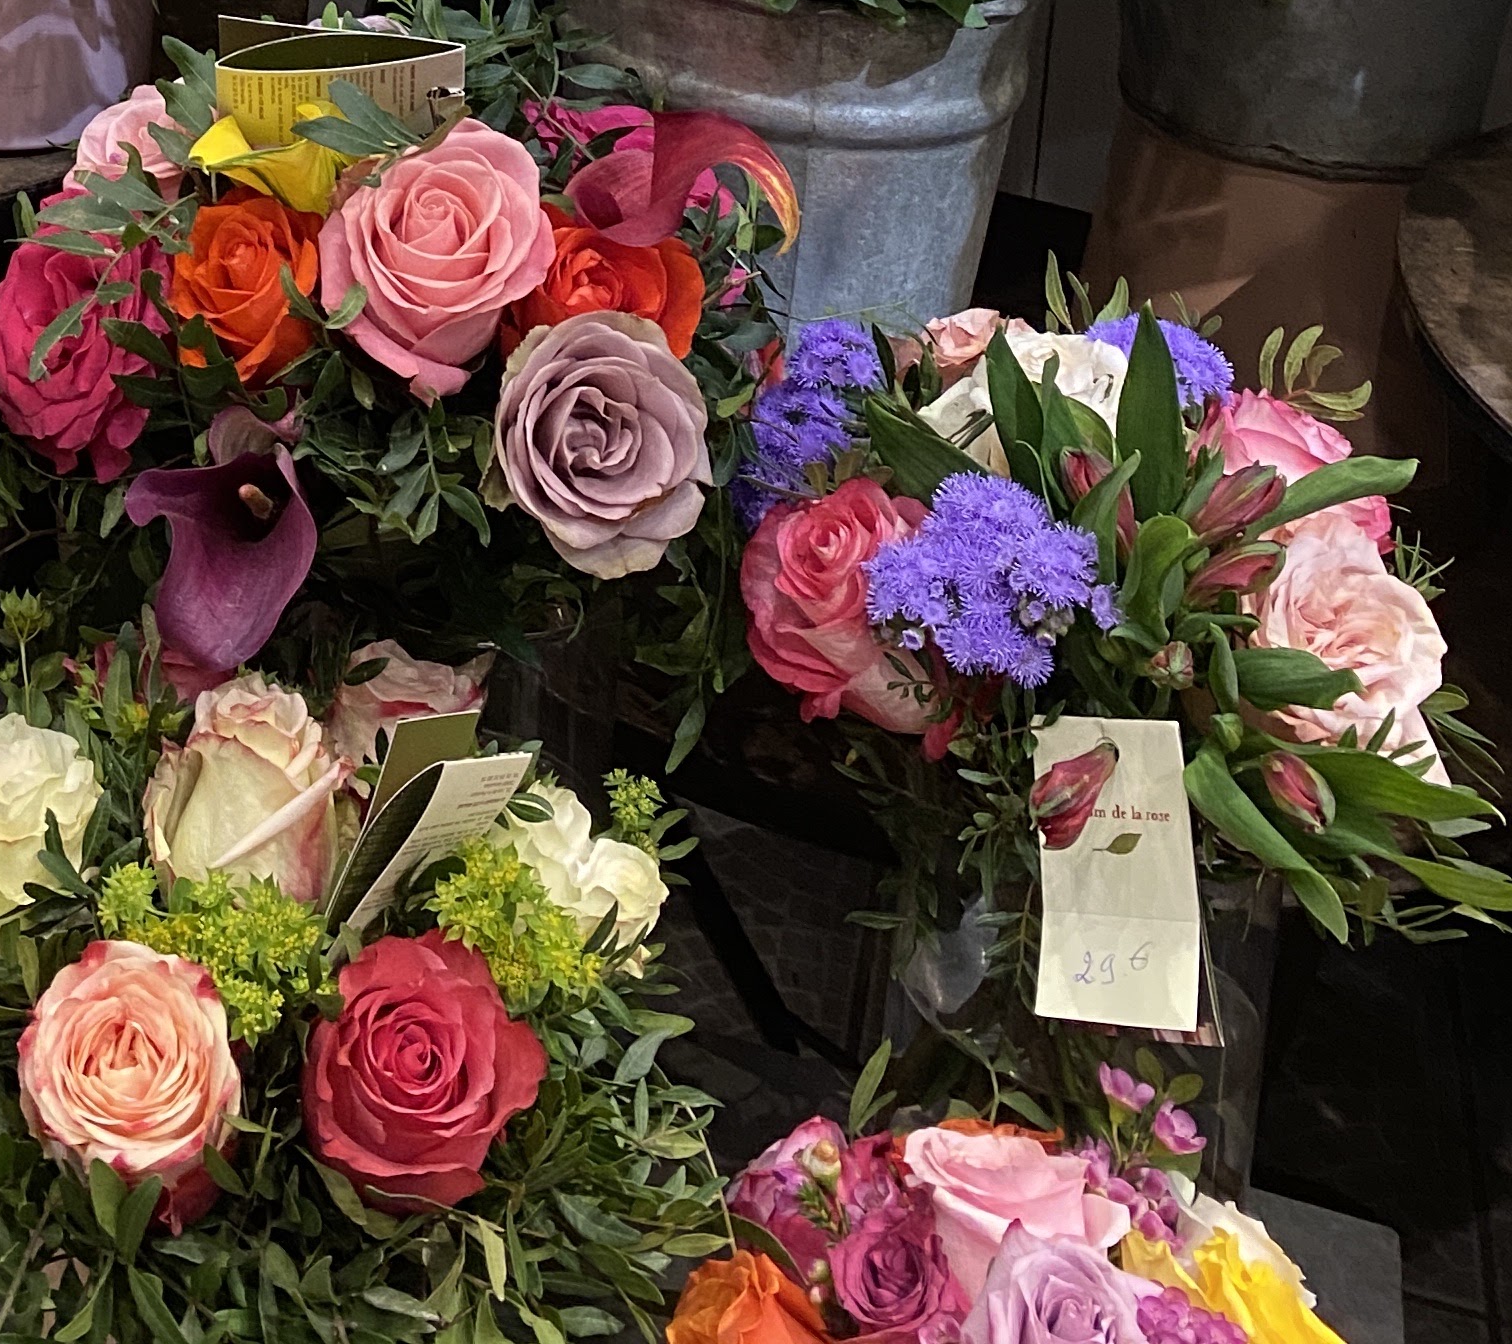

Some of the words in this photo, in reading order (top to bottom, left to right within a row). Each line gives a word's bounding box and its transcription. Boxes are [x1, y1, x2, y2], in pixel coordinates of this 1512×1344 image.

[1111, 803, 1127, 820] de
[1130, 804, 1143, 821] la
[1145, 810, 1171, 823] rose
